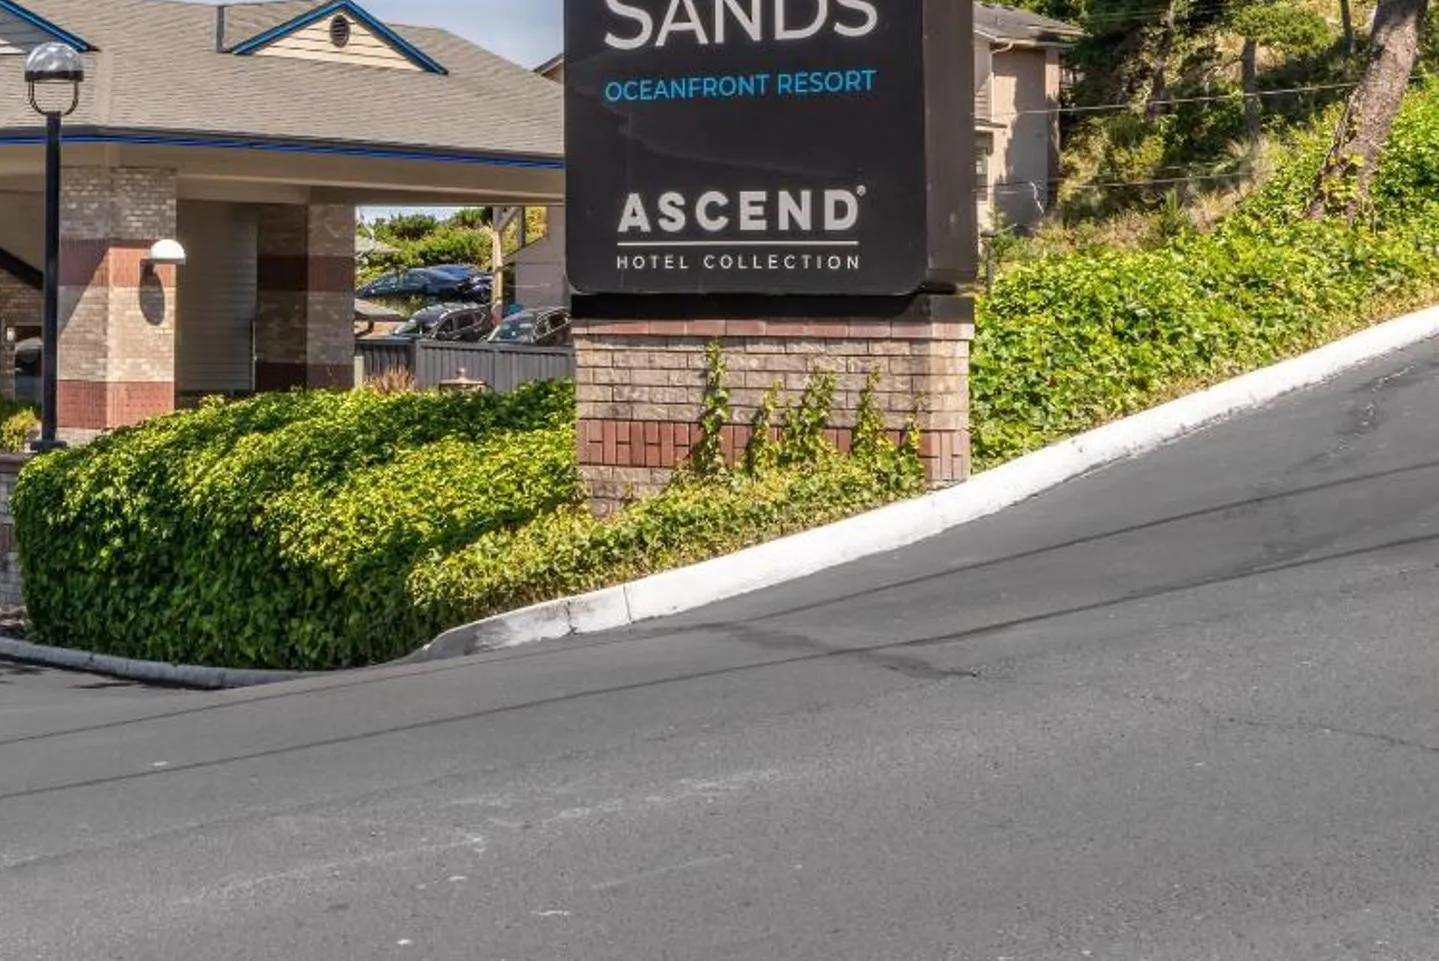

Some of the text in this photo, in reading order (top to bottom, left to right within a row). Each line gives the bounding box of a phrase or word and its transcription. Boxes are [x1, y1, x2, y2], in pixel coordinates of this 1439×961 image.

[605, 69, 877, 102] OCEANFRONT RESORT
[616, 254, 860, 270] HOTEL COLLECTION
